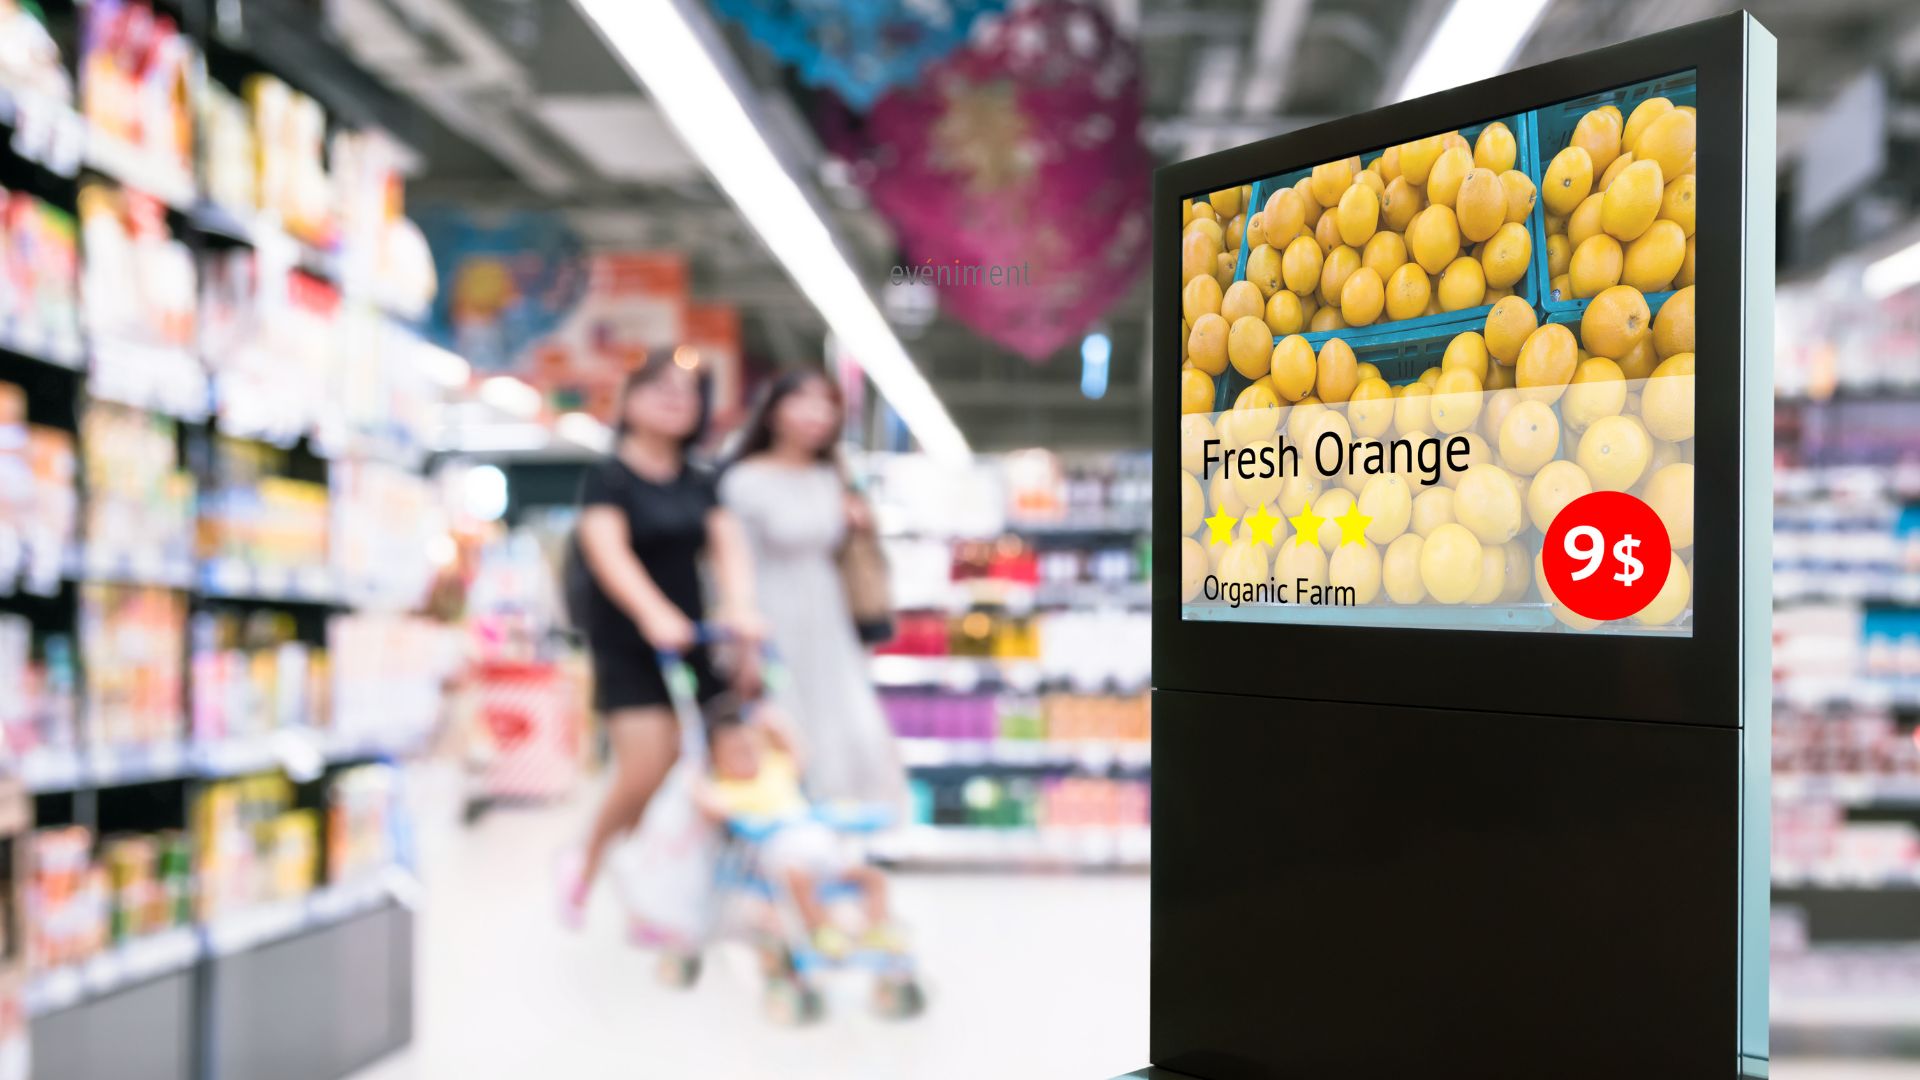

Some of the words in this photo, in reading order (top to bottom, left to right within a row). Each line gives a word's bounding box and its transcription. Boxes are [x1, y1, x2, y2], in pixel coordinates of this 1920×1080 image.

[1203, 435, 1299, 481] Fresh
[1315, 431, 1471, 486] Orange
[1203, 574, 1288, 609] Organic
[1296, 577, 1356, 607] Farm
